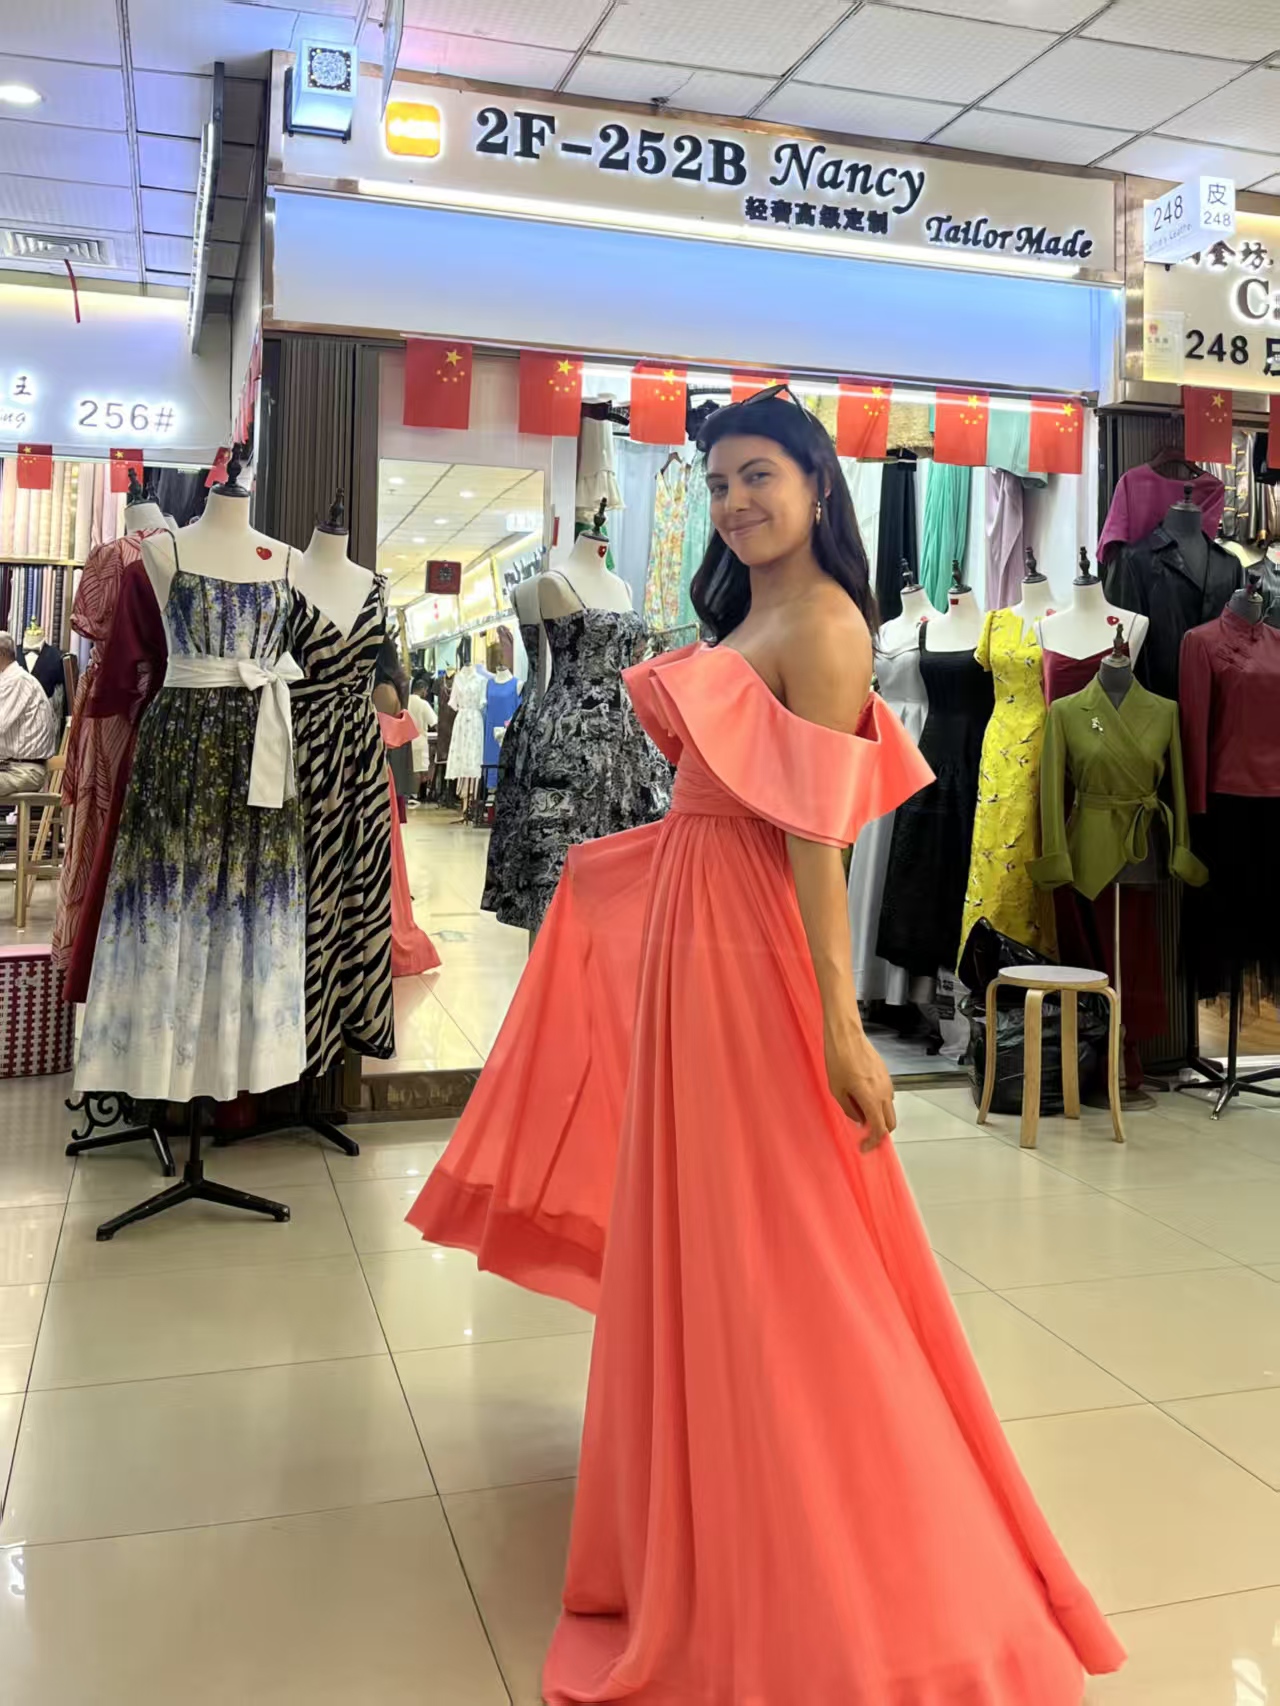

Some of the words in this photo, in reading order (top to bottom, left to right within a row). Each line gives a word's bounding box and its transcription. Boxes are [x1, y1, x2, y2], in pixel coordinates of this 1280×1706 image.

[475, 107, 748, 186] 2F-252B
[769, 143, 925, 215] Nancy
[1207, 183, 1228, 206] 皮
[1152, 194, 1184, 232] 248
[1203, 210, 1231, 227] 248
[926, 215, 1013, 249] Tailor
[1014, 227, 1093, 258] Made
[1184, 329, 1249, 365] 248
[78, 400, 174, 433] 256#
